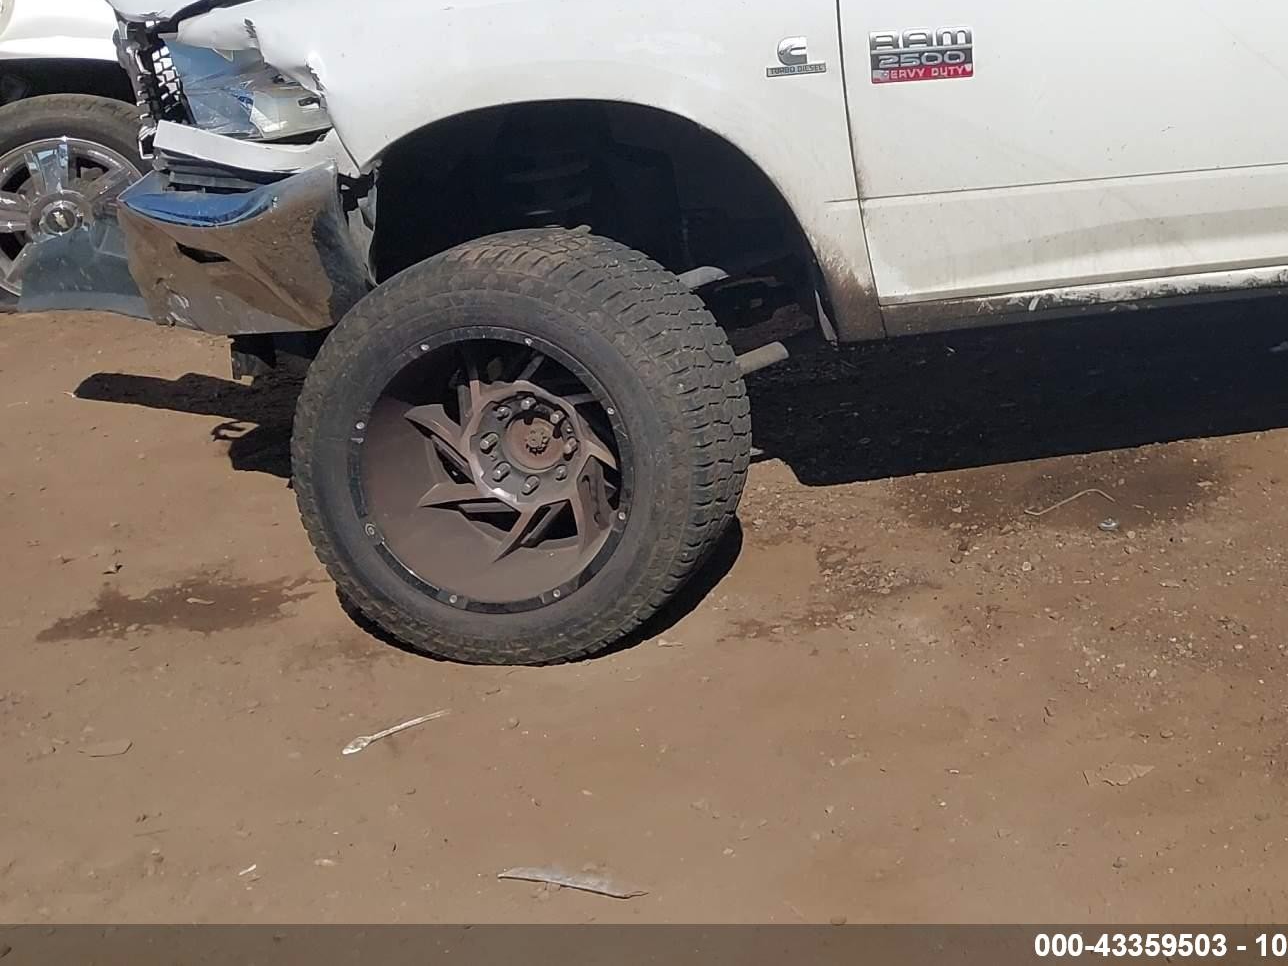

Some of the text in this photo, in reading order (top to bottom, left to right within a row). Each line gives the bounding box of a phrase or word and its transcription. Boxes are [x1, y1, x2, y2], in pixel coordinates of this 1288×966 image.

[869, 26, 972, 51] RAM
[879, 50, 966, 69] 2500
[769, 64, 825, 75] TURBO DIESEL
[931, 65, 964, 76] DUTY
